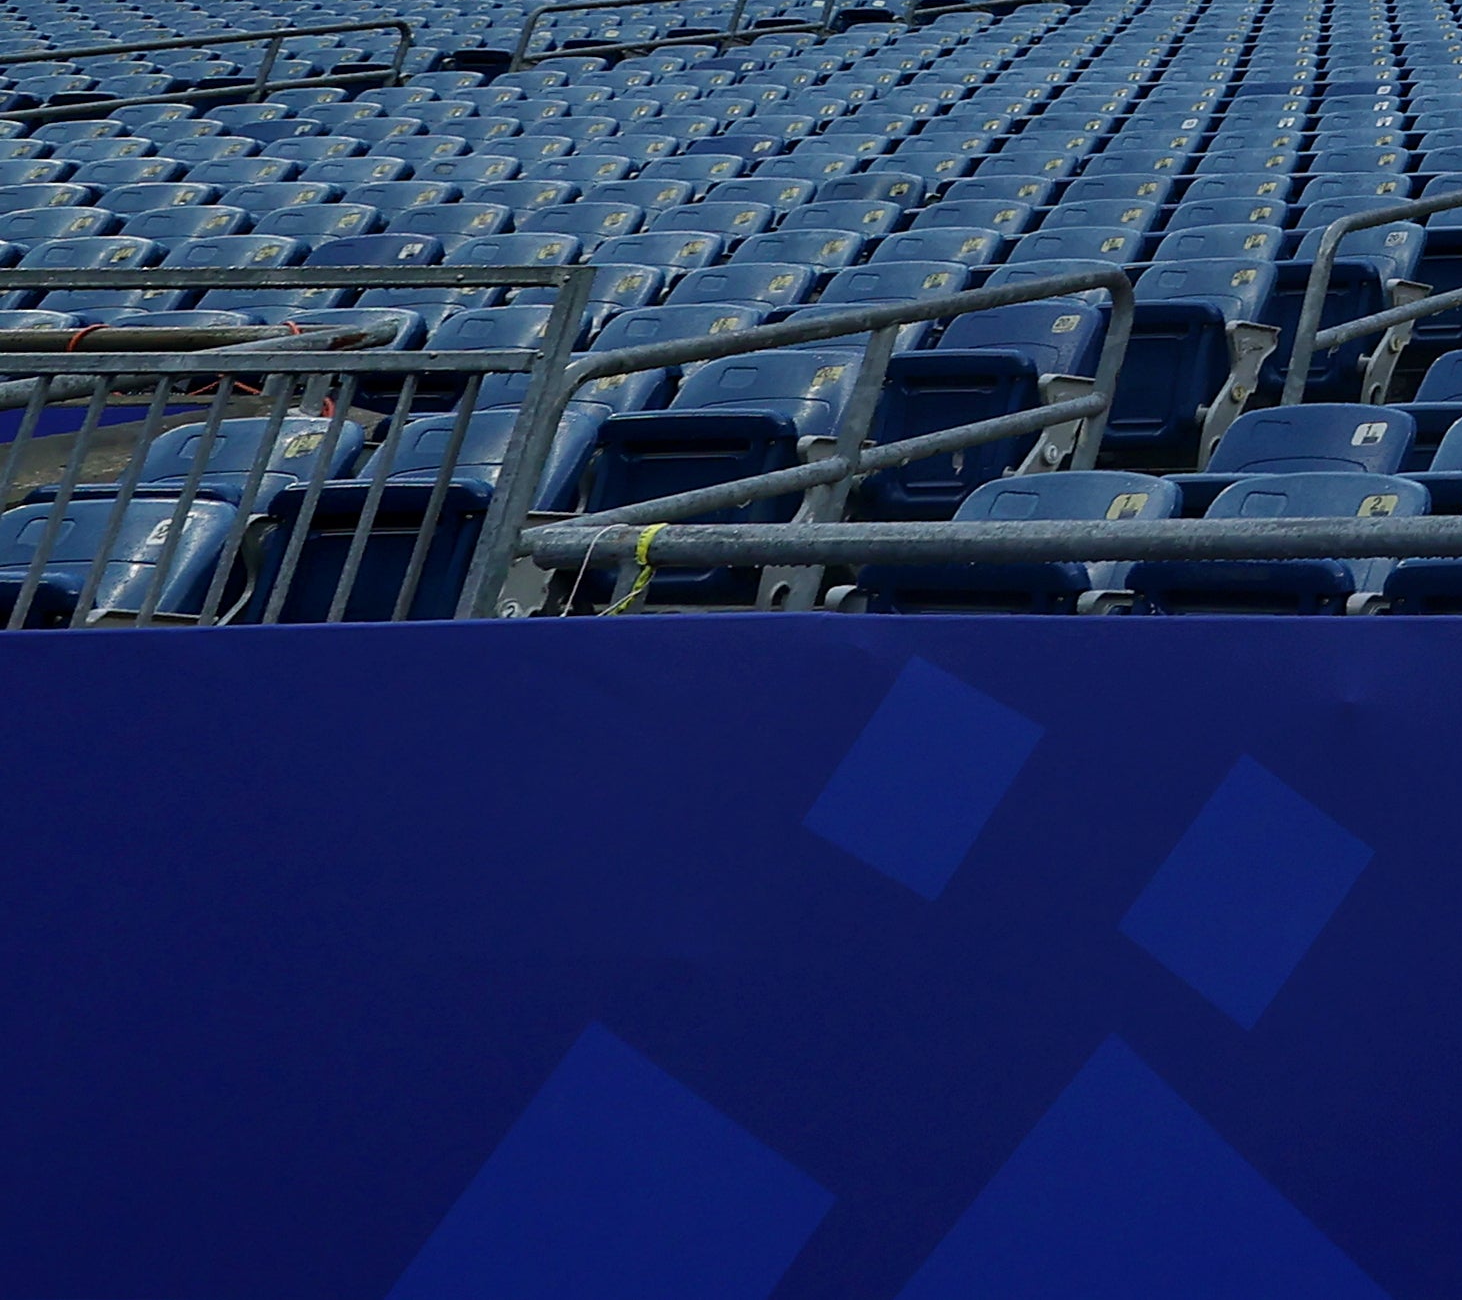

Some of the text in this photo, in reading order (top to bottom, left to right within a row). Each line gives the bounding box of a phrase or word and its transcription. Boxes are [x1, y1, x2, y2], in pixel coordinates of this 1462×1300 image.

[1366, 425, 1372, 435] 1
[1124, 496, 1130, 508] 1
[1372, 497, 1382, 510] 2
